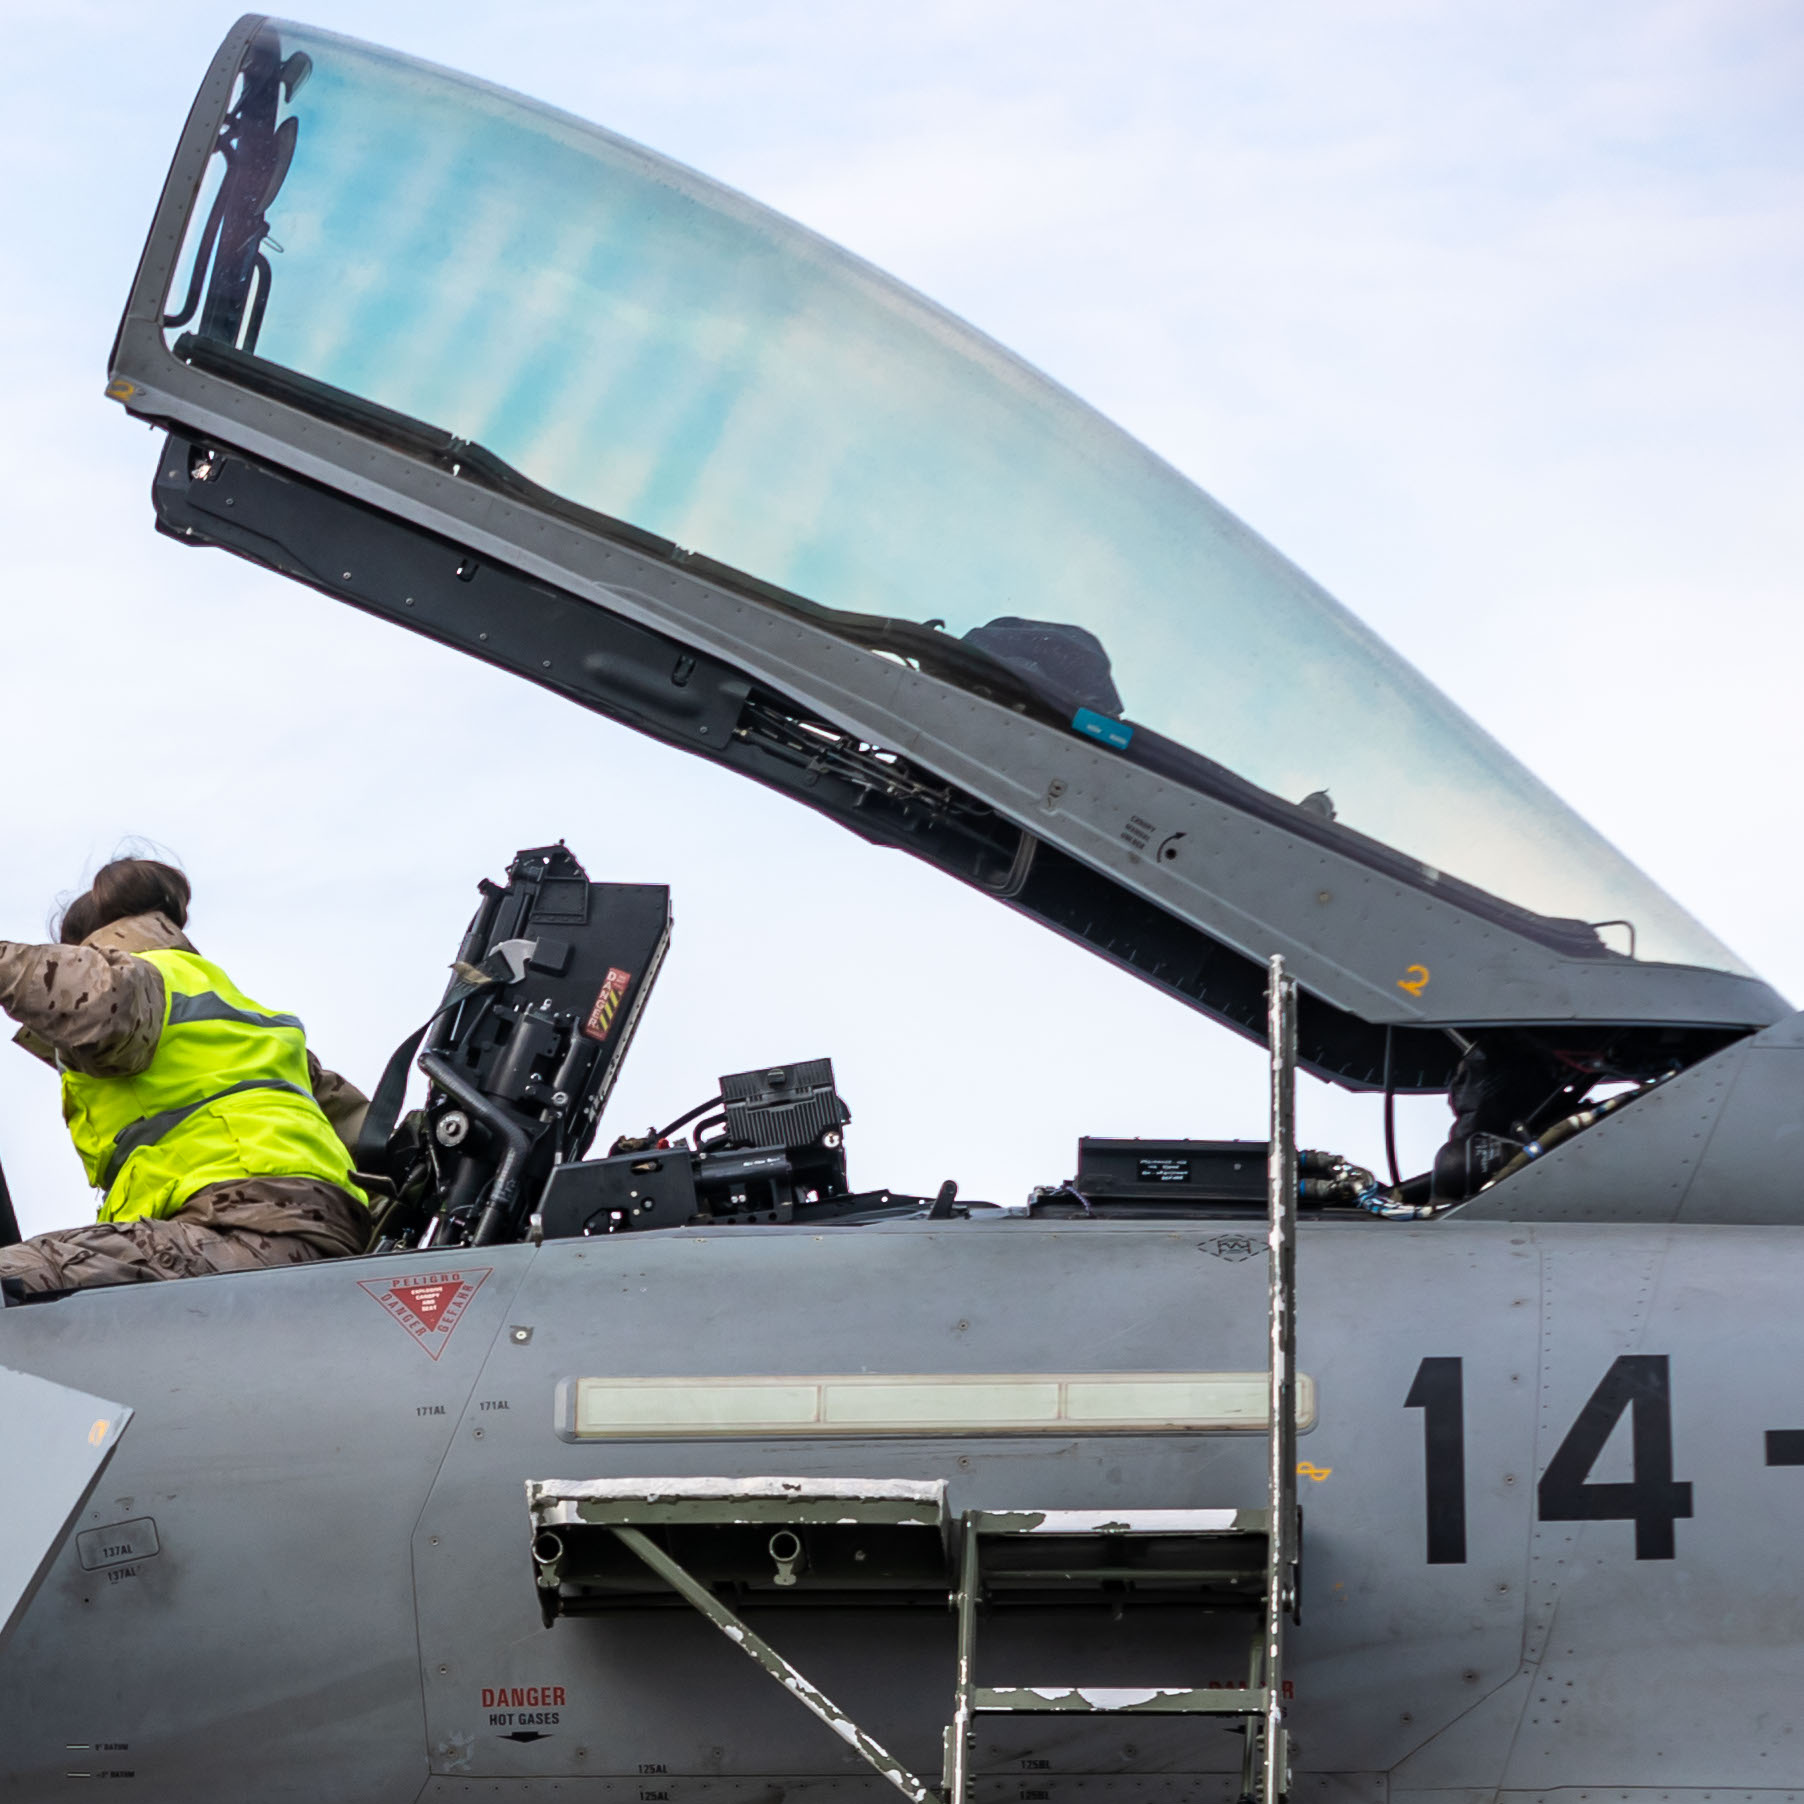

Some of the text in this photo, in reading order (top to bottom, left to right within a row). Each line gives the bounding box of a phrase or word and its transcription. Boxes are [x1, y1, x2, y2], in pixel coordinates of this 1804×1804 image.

[588, 970, 617, 1027] DANGER
[392, 1273, 461, 1287] PELIGRO
[380, 1292, 427, 1337] DANGER
[437, 1284, 474, 1333] GEFAHR
[416, 1405, 446, 1416] 171AL
[480, 1401, 510, 1411] 171AL
[103, 1544, 133, 1557] 137AL
[107, 1567, 137, 1581] 137AL
[481, 1686, 566, 1708] DANGER
[489, 1712, 560, 1725] HOT GASES
[638, 1764, 668, 1774] 125AL
[640, 1791, 670, 1801] 125AL
